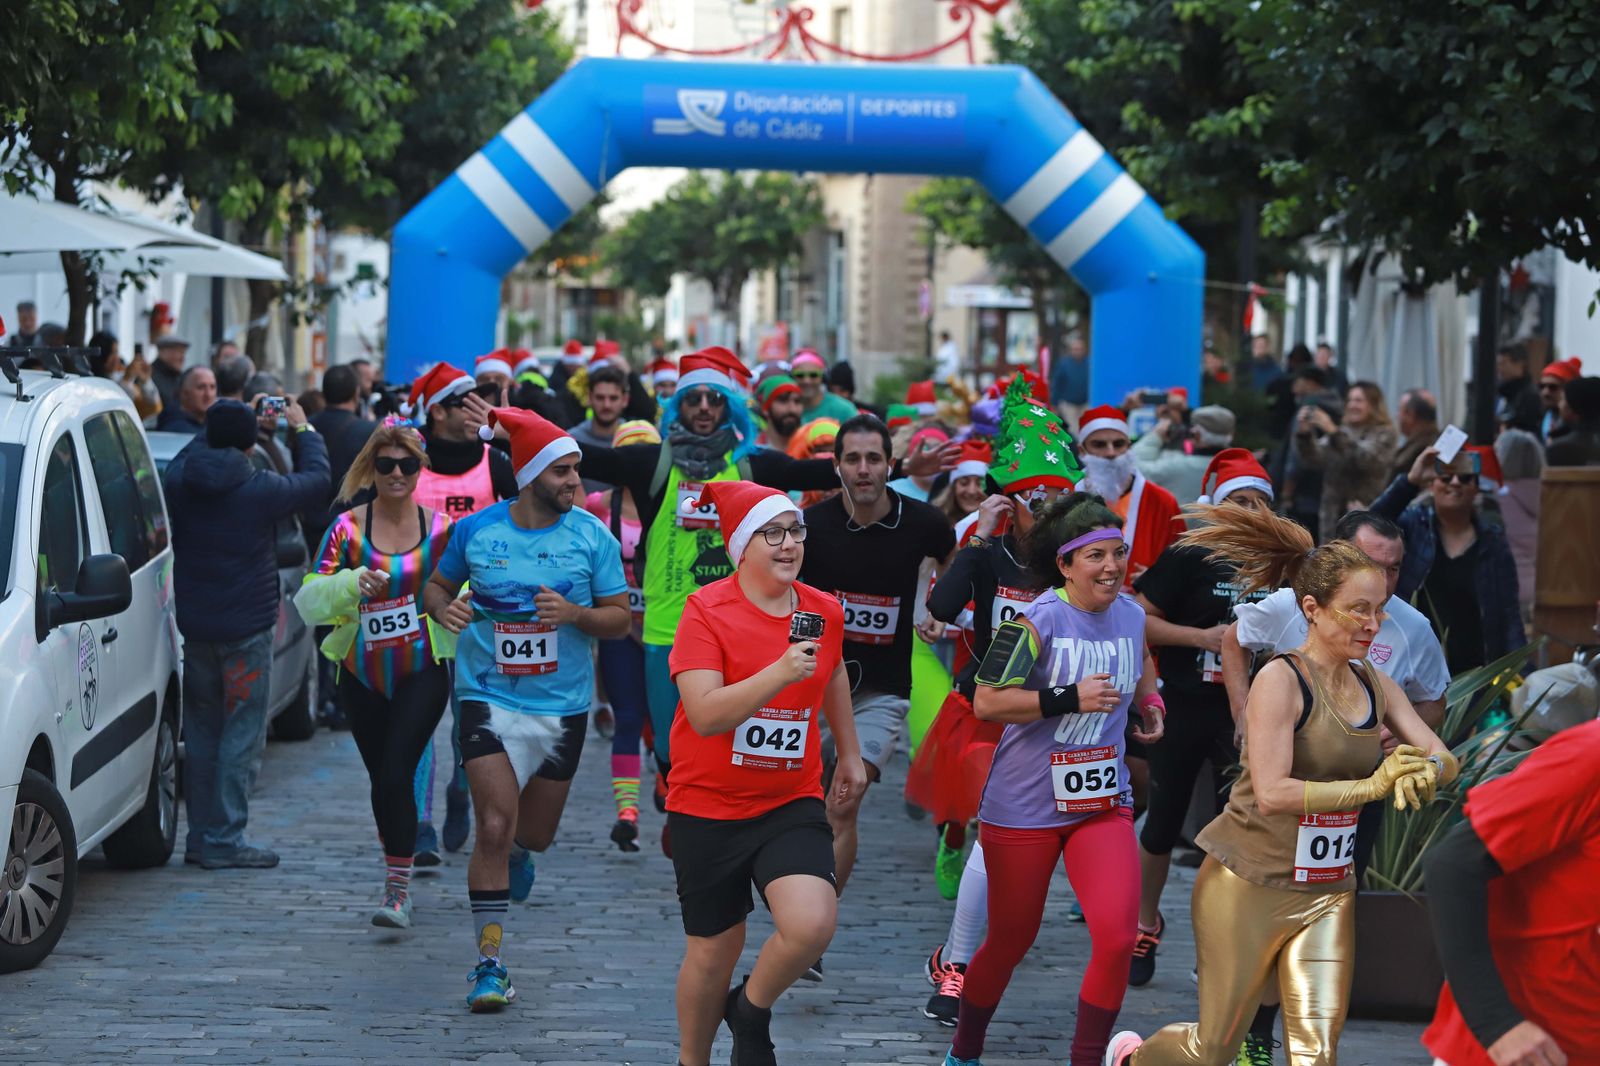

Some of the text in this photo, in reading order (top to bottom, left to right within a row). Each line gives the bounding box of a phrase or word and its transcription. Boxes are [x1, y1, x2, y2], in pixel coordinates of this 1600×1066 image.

[734, 91, 844, 115] Diputación
[861, 98, 957, 118] DEPORTES
[733, 117, 824, 140] de Cádiz
[446, 496, 475, 512] FER
[695, 565, 730, 577] STAFF
[368, 612, 411, 635] 053
[844, 607, 889, 629] 039
[501, 638, 547, 659] 041
[1048, 637, 1138, 694] TYPICAL
[745, 725, 802, 751] 042
[1064, 765, 1117, 793] 052
[1310, 832, 1356, 861] 012
